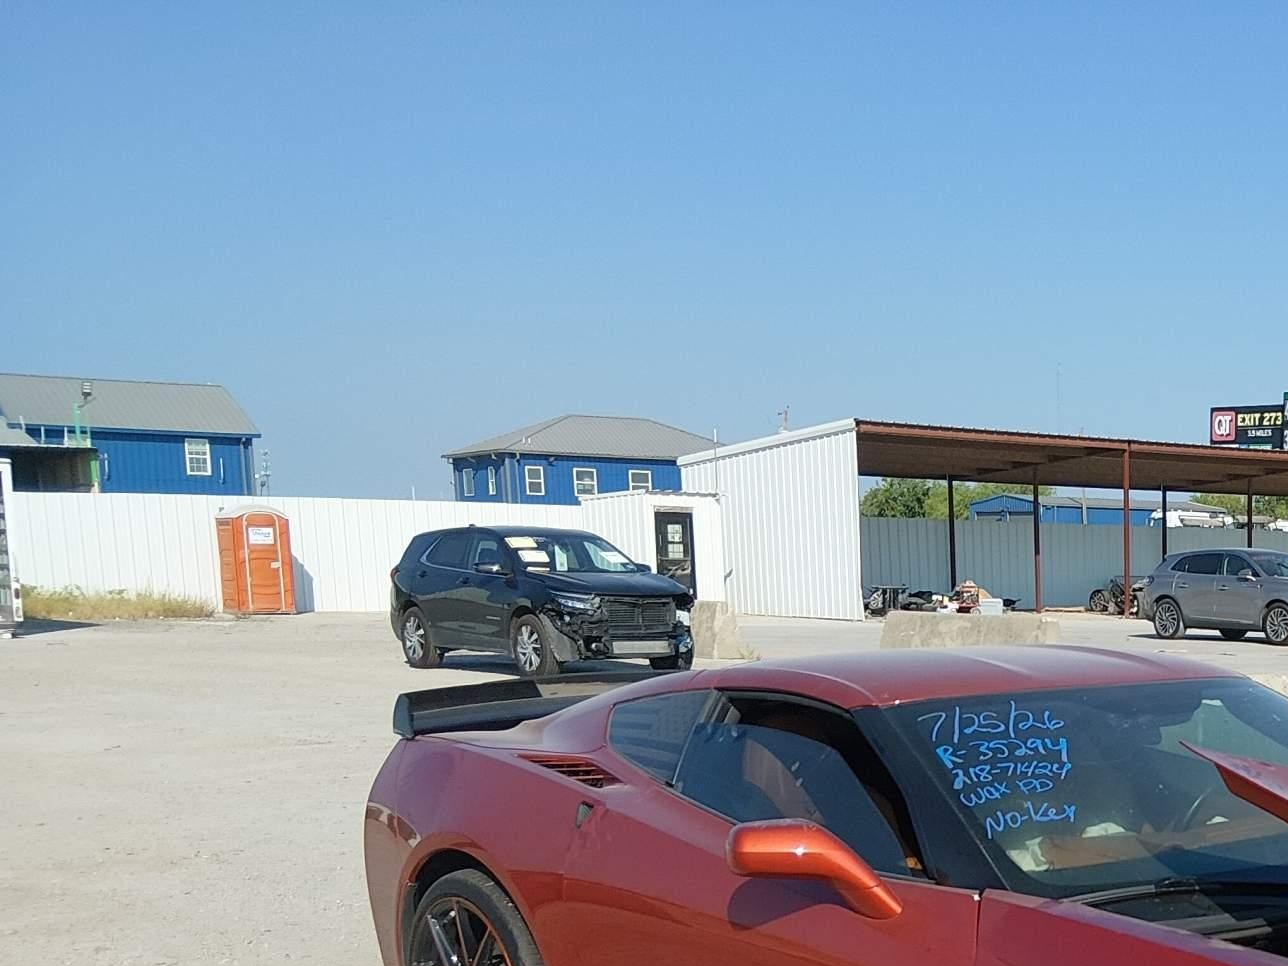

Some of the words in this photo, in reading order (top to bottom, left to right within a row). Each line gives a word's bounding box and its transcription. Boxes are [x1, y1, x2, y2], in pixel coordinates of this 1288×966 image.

[1214, 415, 1232, 436] QT
[1237, 413, 1261, 426] EXIT
[1263, 412, 1282, 425] 273
[917, 700, 1065, 743] 7/25/26
[1016, 778, 1054, 795] PD
